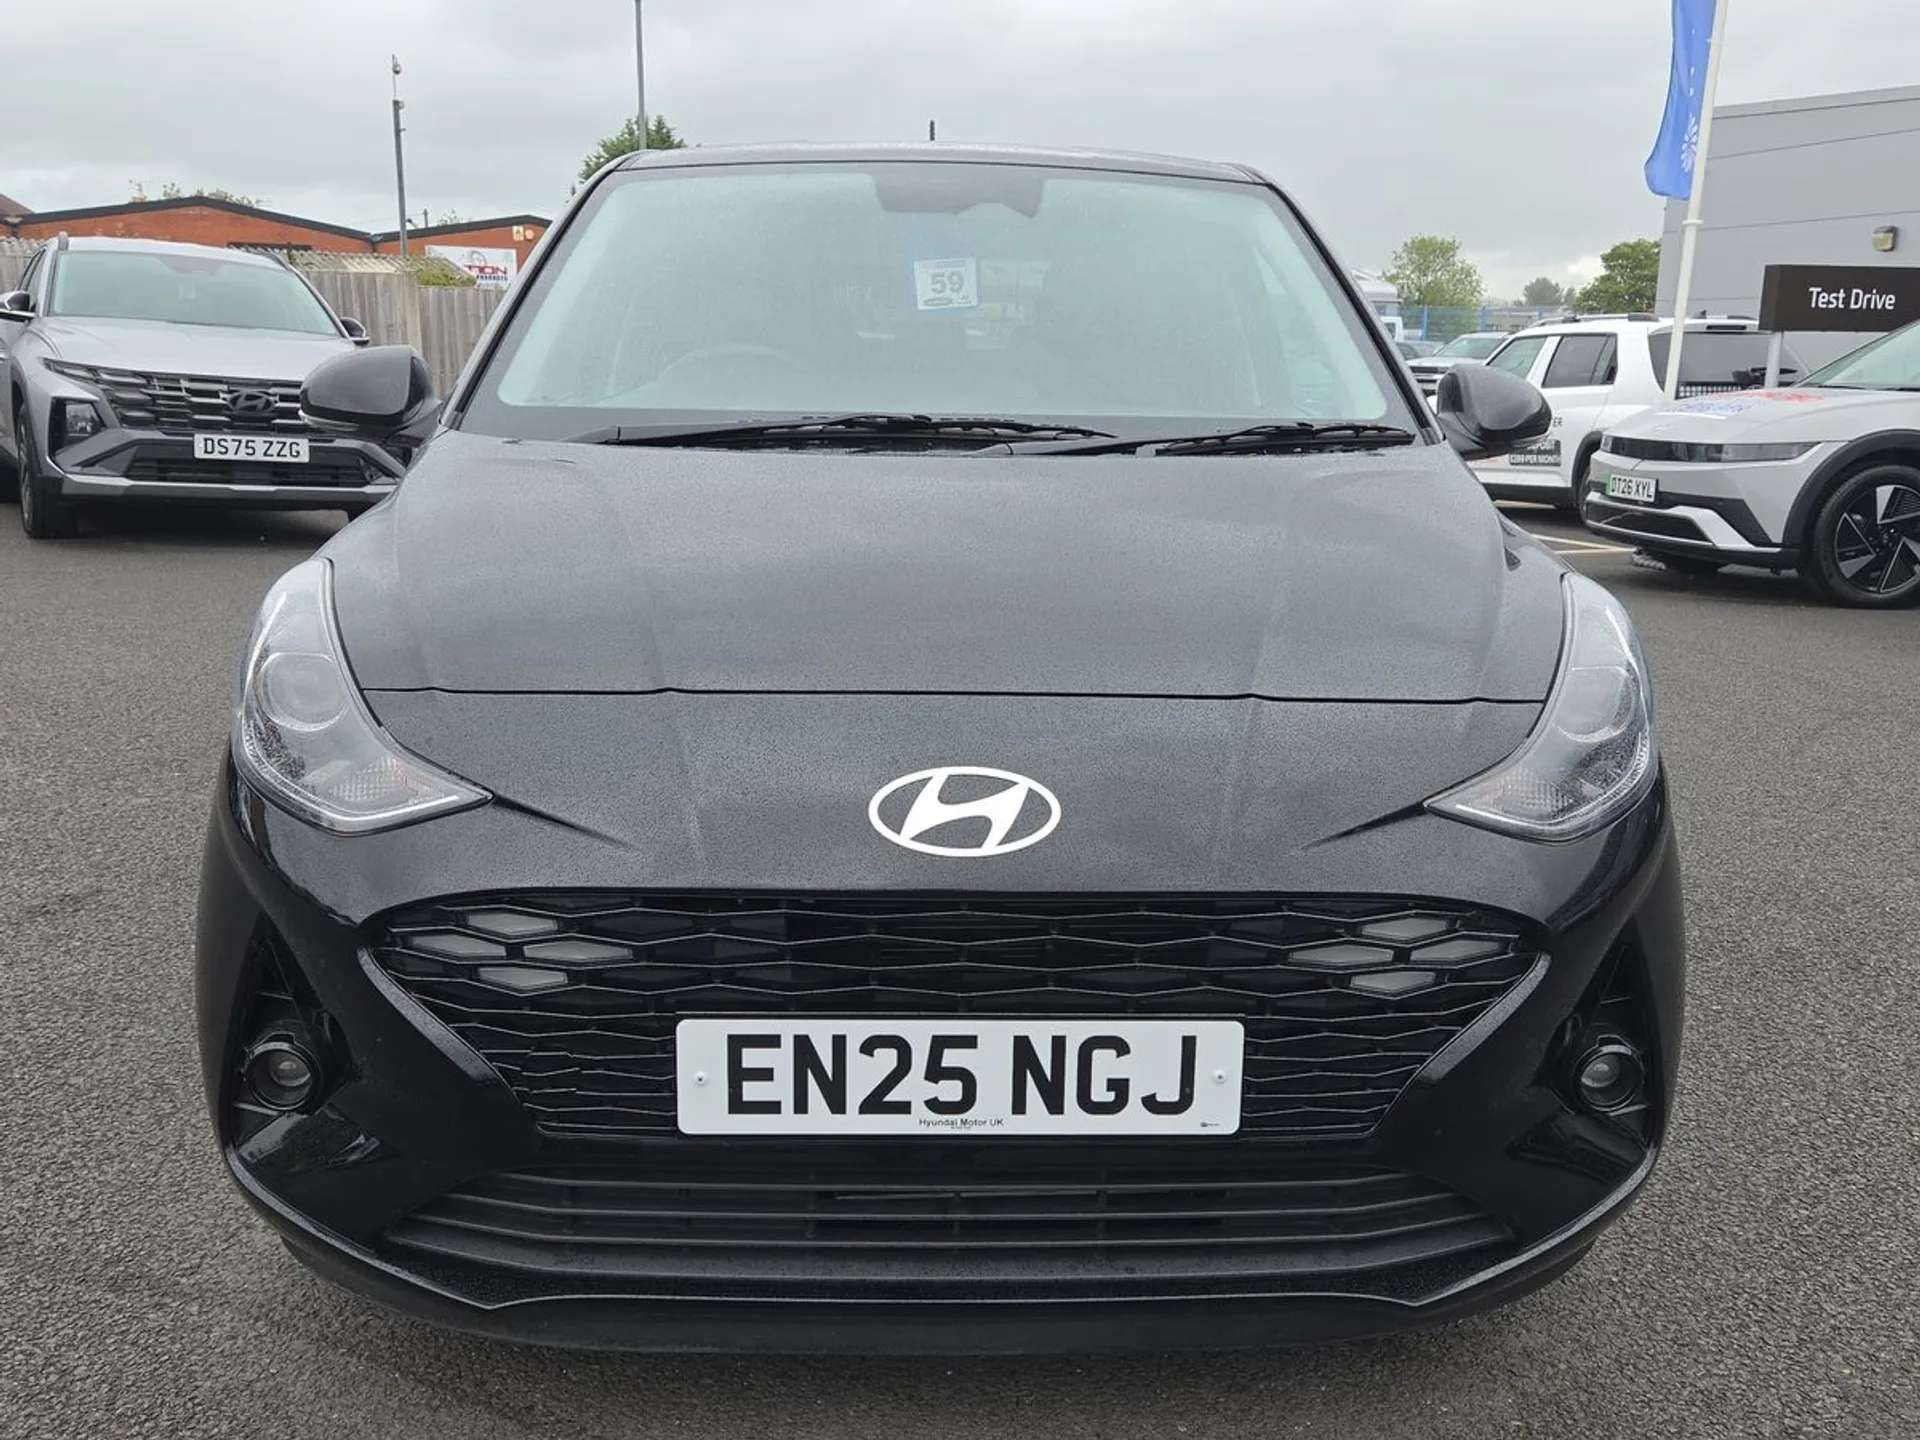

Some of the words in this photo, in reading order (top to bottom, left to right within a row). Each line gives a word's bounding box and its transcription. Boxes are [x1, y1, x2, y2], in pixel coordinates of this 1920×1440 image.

[930, 271, 964, 294] 59
[1808, 287, 1846, 309] Test
[1850, 288, 1896, 310] Drive
[203, 437, 256, 457] DS75
[263, 440, 301, 458] ZZG
[1611, 477, 1633, 496] DT26
[1634, 479, 1653, 499] XYL
[726, 1033, 979, 1116] EN25
[1010, 1034, 1198, 1116] NGJ
[919, 1118, 958, 1128] Hyundai
[960, 1118, 987, 1127] Motor
[989, 1118, 1005, 1127] UK
